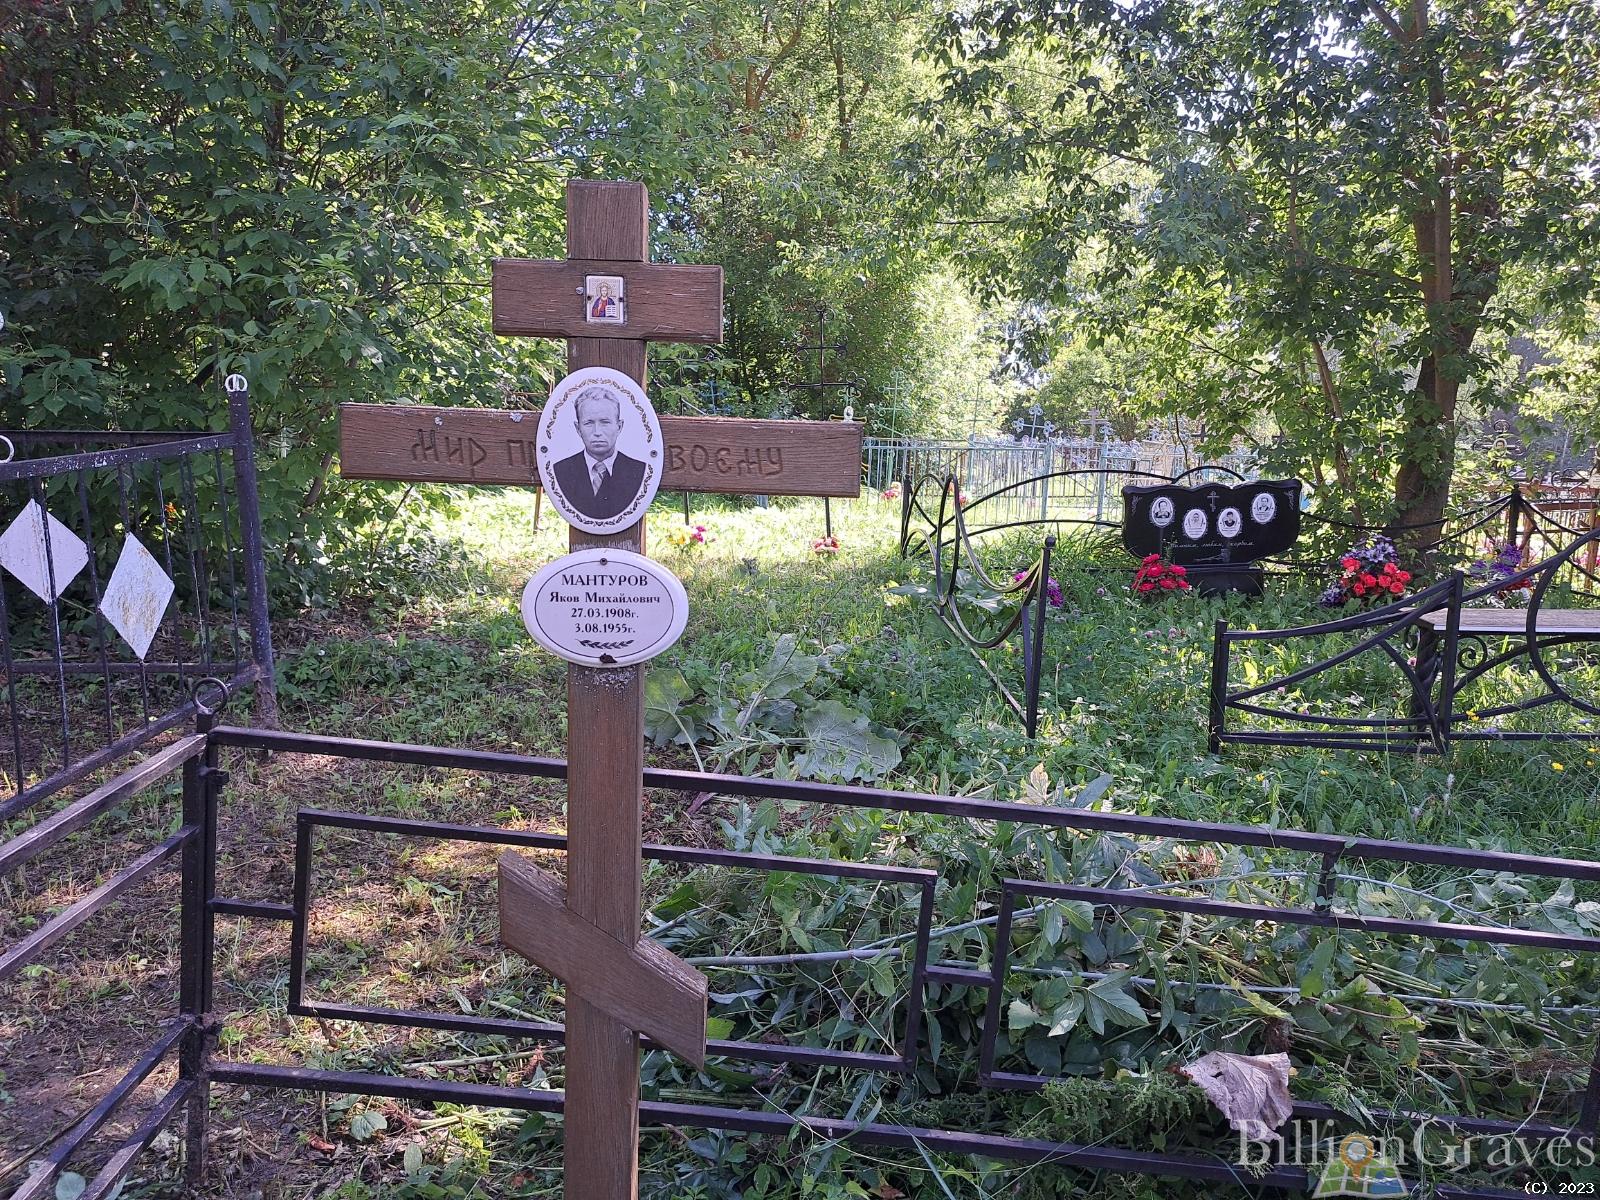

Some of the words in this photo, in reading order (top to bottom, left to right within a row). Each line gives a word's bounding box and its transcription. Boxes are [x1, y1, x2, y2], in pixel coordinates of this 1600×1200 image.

[561, 574, 648, 587] МАНТУРОВ
[550, 592, 580, 603] Яков
[585, 592, 660, 604] Михайлович
[571, 608, 639, 619] 27.03.1908г.
[575, 623, 636, 634] 3.08.1955г.
